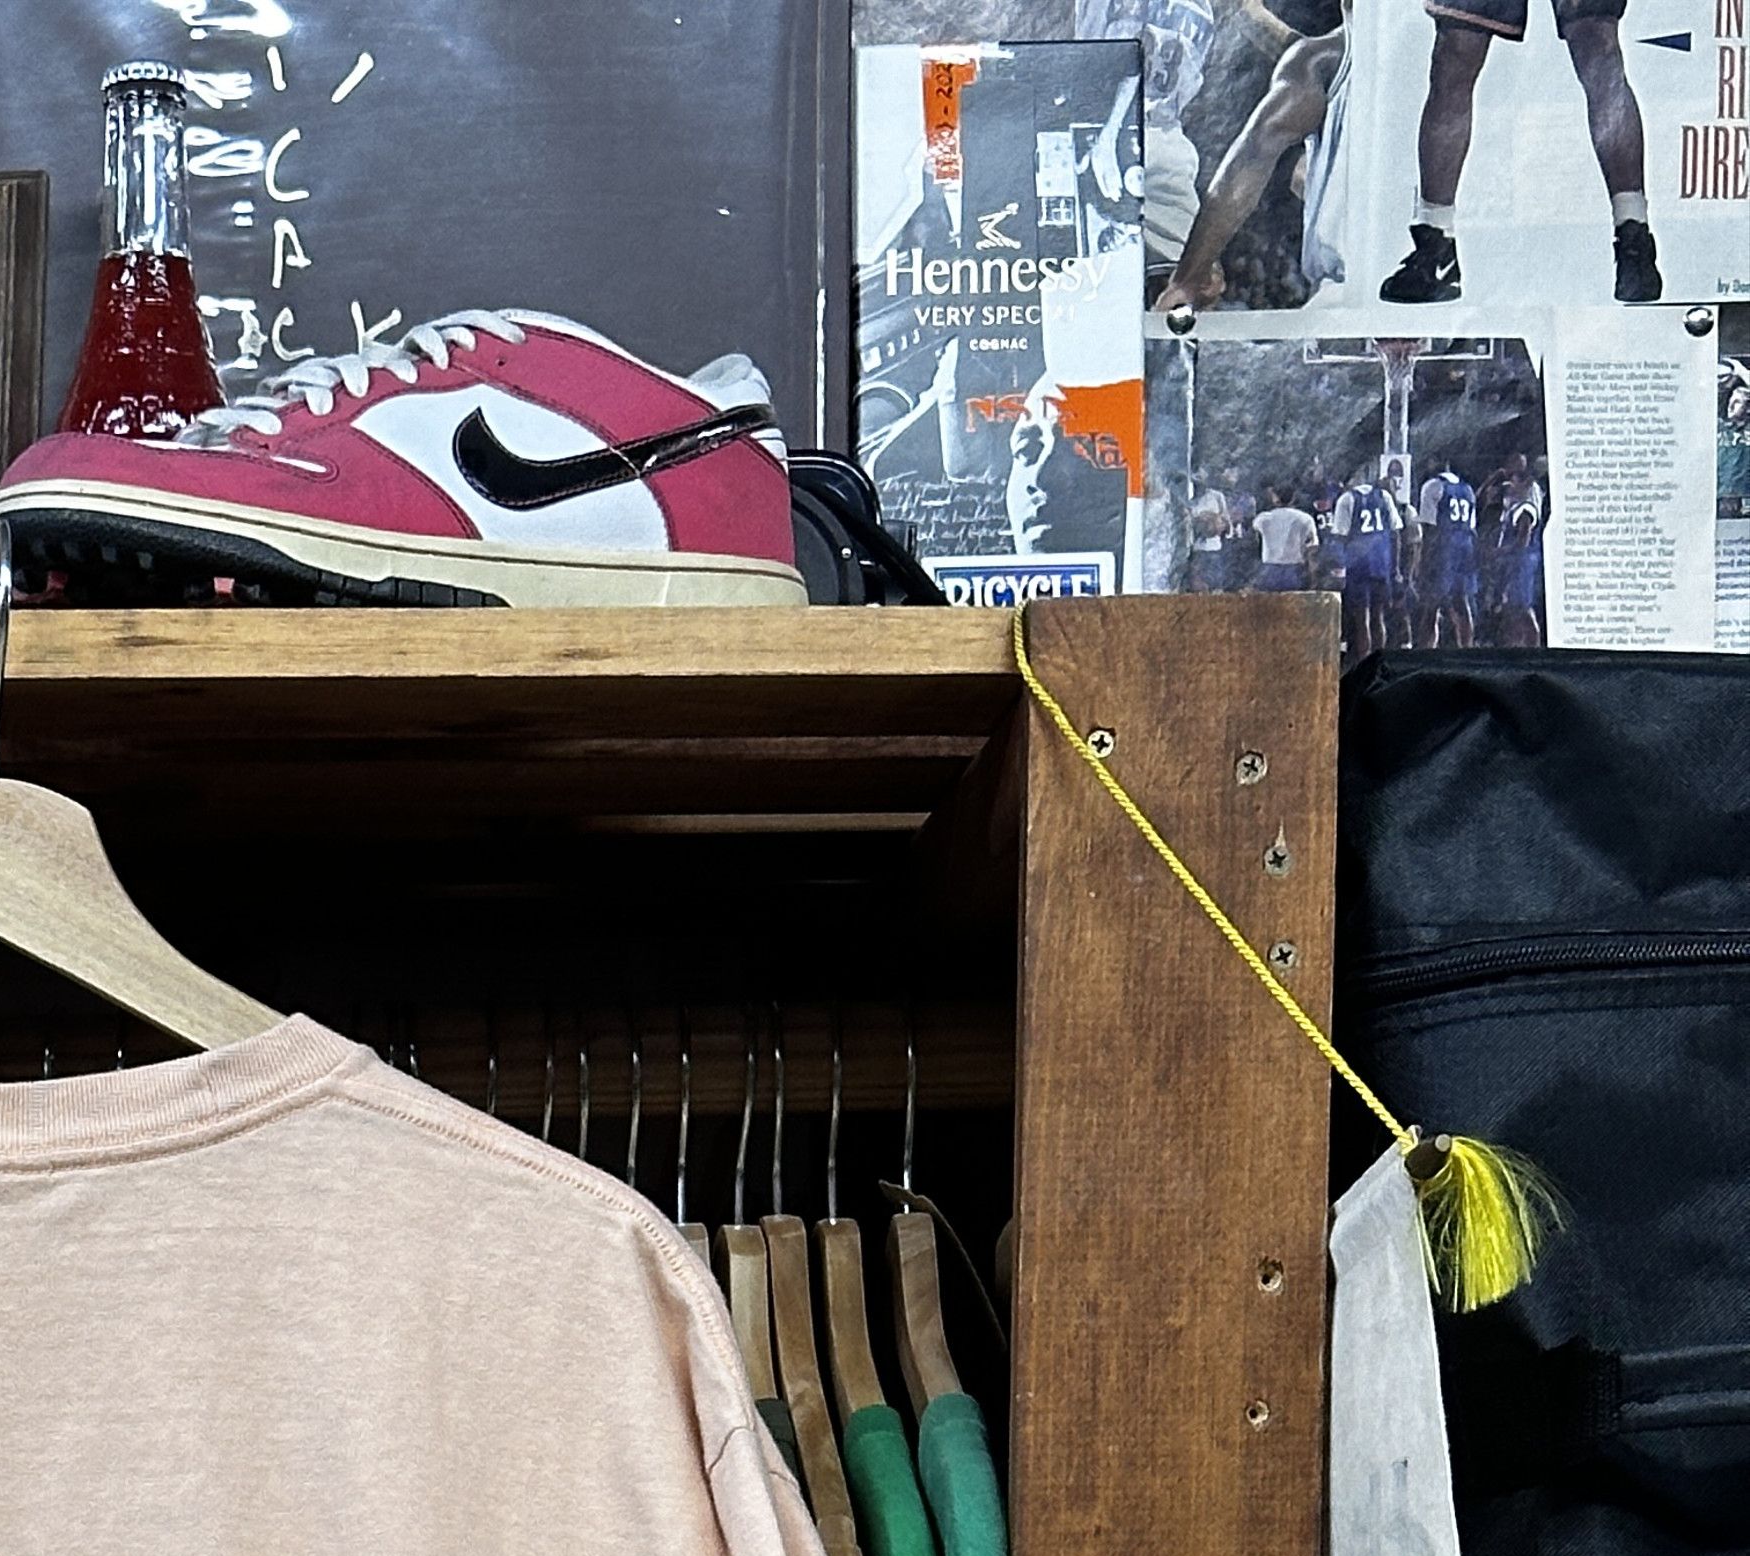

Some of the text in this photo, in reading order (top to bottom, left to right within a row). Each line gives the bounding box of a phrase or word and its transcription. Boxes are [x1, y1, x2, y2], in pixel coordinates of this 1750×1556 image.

[1714, 0, 1743, 38] IN
[1680, 125, 1750, 200] DIRE
[886, 248, 1110, 301] Hennessy
[914, 304, 1076, 326] VERY SPECAL
[969, 338, 1028, 351] COGNAC
[1360, 508, 1383, 533] 21
[1450, 498, 1470, 522] 33
